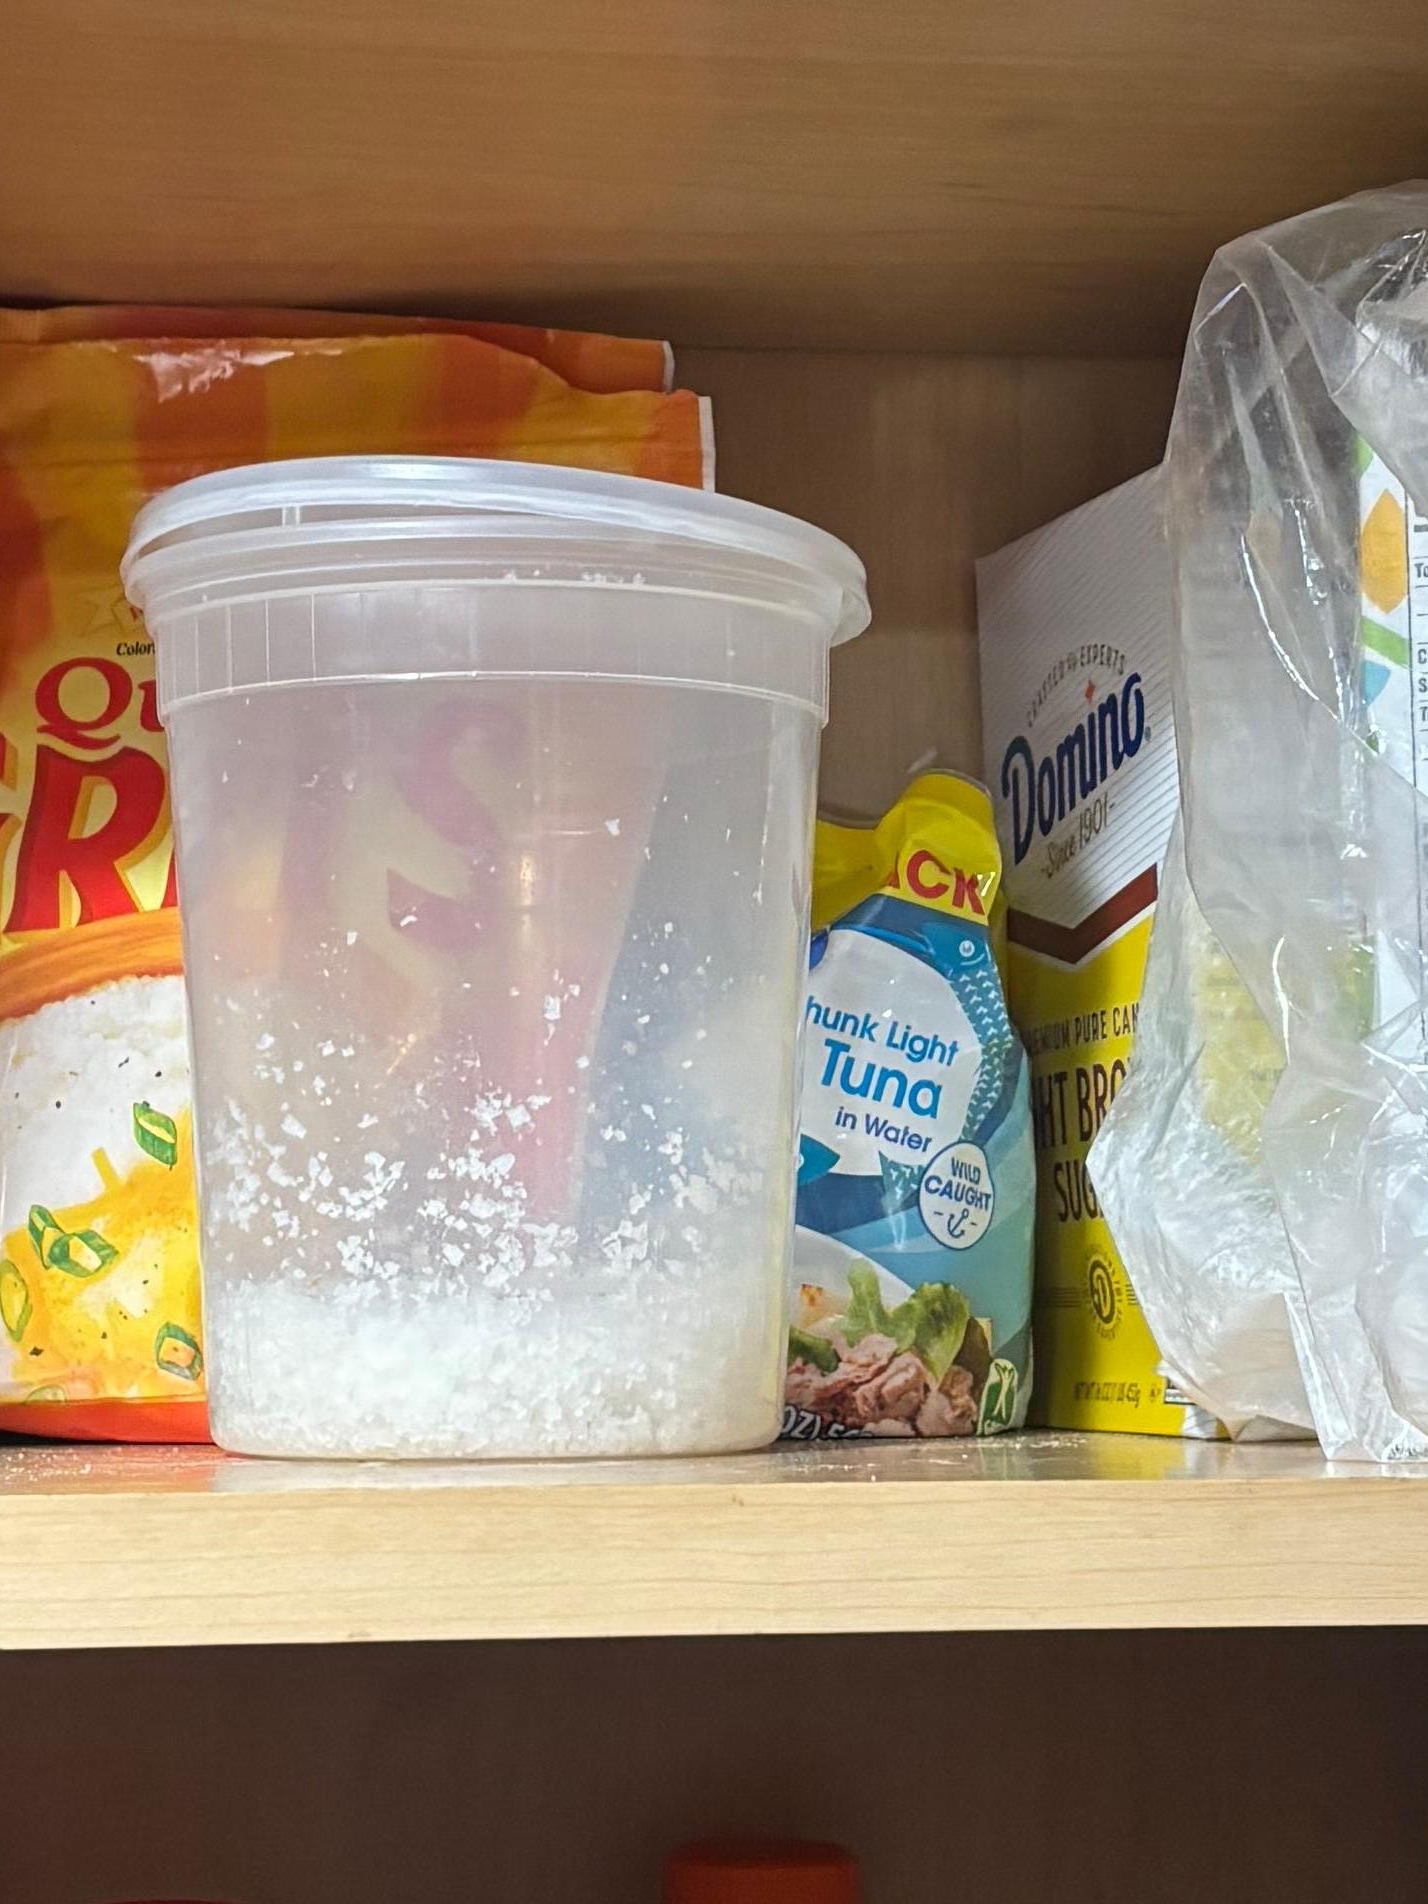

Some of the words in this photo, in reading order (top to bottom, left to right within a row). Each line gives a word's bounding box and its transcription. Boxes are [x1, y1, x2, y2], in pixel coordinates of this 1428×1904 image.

[1080, 643, 1126, 675] EXPERTS
[1002, 672, 1145, 865] Domino
[806, 995, 880, 1041] hunk
[885, 1021, 959, 1068] Light
[1075, 1011, 1107, 1045] PURE
[821, 1039, 943, 1120] Tuna
[835, 1106, 857, 1130] in
[864, 1114, 933, 1154] Water
[950, 1156, 982, 1186] WILD
[924, 1175, 992, 1213] CAUGHT
